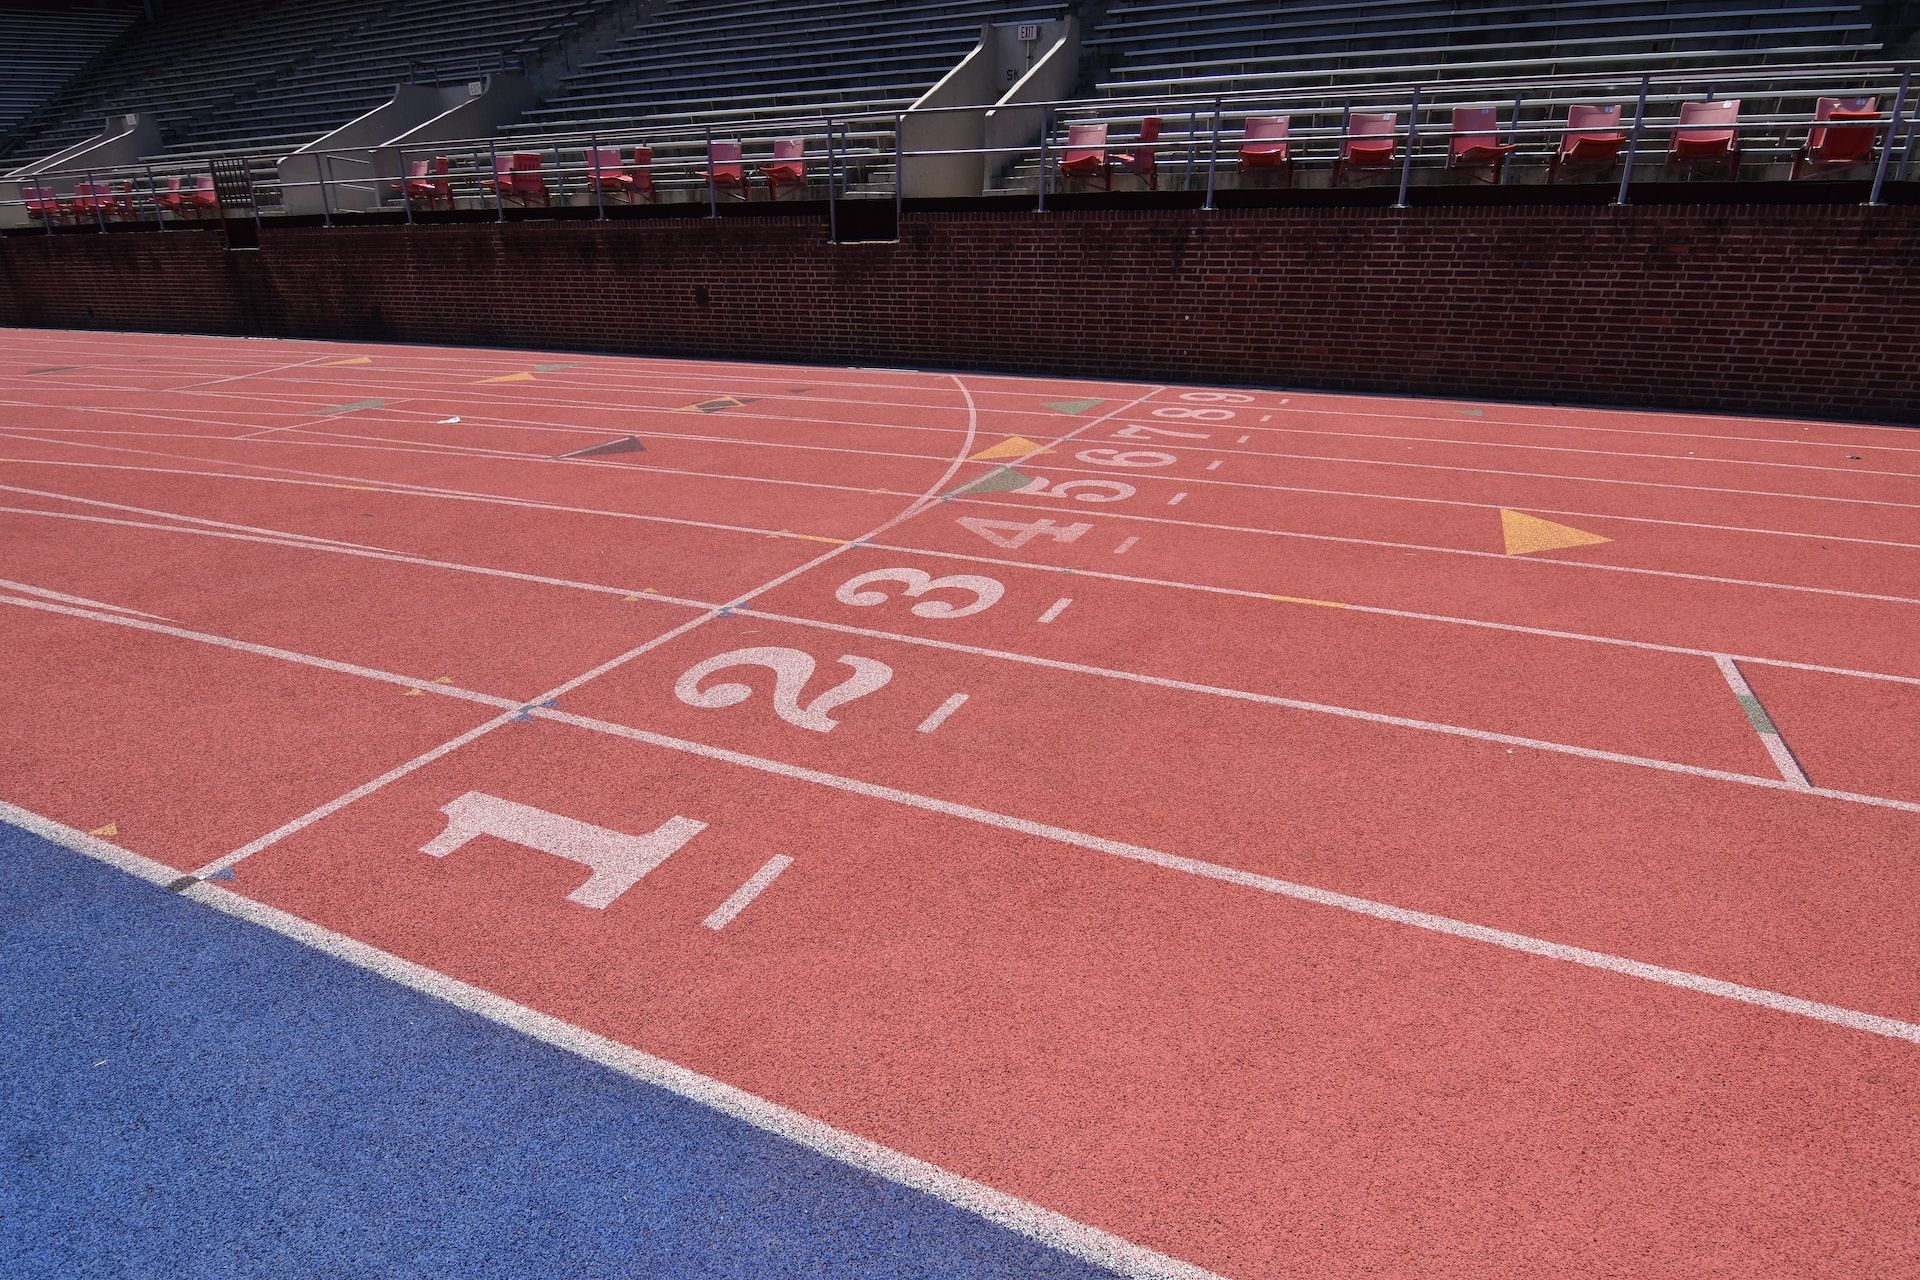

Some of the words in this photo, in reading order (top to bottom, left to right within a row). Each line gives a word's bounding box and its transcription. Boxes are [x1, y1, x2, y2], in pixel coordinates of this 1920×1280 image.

[1021, 26, 1034, 38] EXIT
[1151, 407, 1236, 421] 8
[1109, 424, 1212, 440] 7
[1075, 448, 1177, 467] 6
[1011, 476, 1137, 503] 5
[955, 516, 1094, 550] 4
[836, 567, 1005, 619] 3
[674, 646, 893, 733] 2
[419, 790, 709, 910] 1
